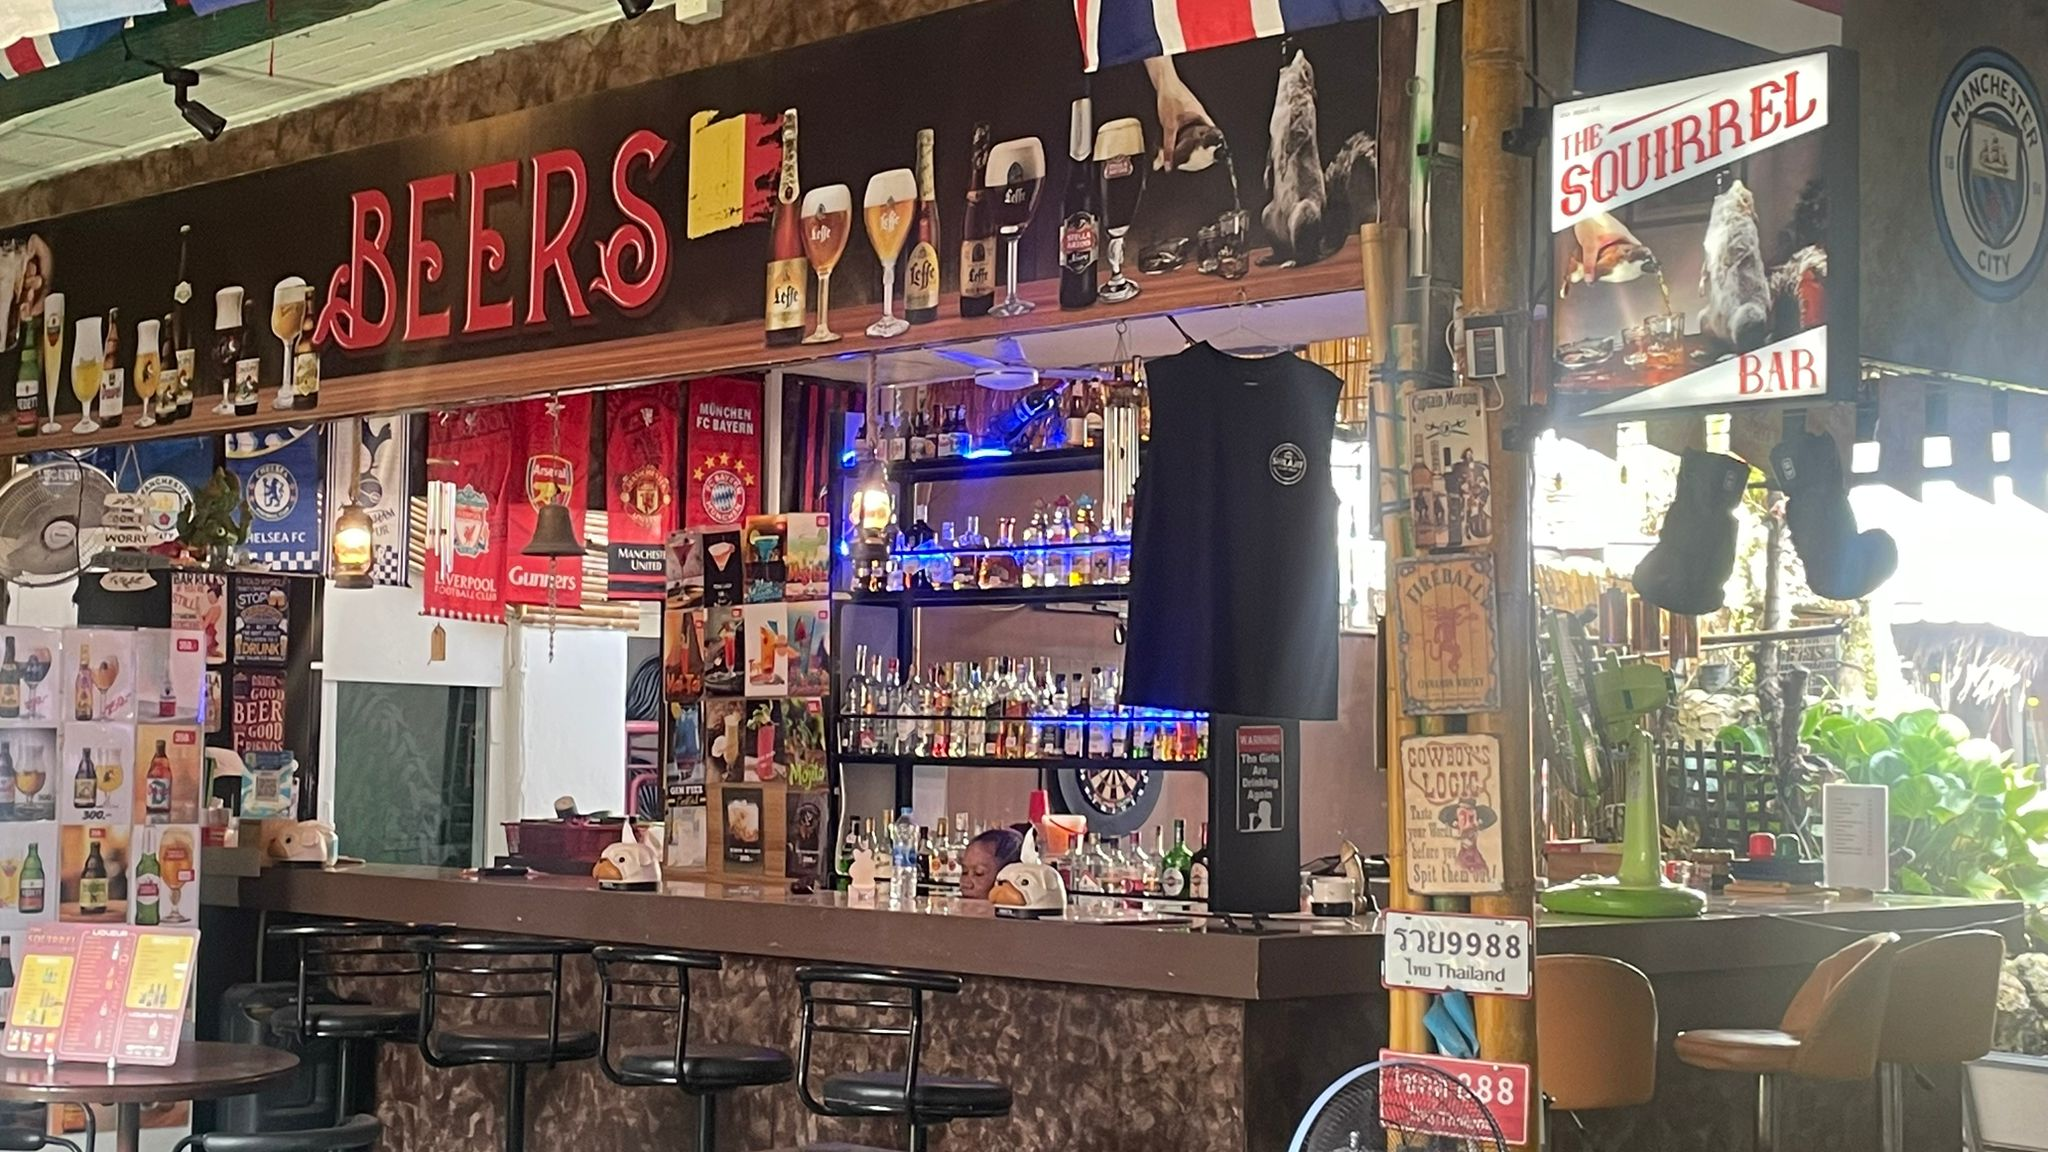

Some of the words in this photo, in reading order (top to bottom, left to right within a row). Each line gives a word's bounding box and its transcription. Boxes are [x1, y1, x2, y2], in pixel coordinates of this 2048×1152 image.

[1950, 74, 2039, 148] MANCHESTER
[1560, 71, 1817, 217] SQUIRREL
[1561, 123, 1603, 161] THE
[312, 130, 671, 350] BEERS
[810, 224, 831, 243] Leffe
[1977, 251, 2011, 275] CITY
[909, 259, 935, 290] Leffe
[968, 267, 989, 283] Leffe
[773, 285, 799, 309] Leffe
[1738, 348, 1820, 395] BAR
[700, 403, 751, 420] MÜNCHEN
[1412, 393, 1446, 414] Captain
[1443, 390, 1478, 409] Morgan
[696, 416, 710, 430] FC
[712, 419, 754, 435] BAYERN
[105, 534, 148, 544] WORRY
[246, 531, 289, 543] HELSEA
[291, 532, 306, 543] FC
[618, 548, 666, 560] MANCHESTE
[631, 559, 662, 572] UNITED
[508, 565, 576, 591] Gunners
[1406, 567, 1483, 605] FIREBALL
[238, 592, 268, 604] STOP
[434, 585, 474, 599] FOOTBALL
[475, 591, 498, 602] CLUB
[241, 643, 280, 656] DRUNK
[250, 687, 285, 701] GOOD
[234, 700, 283, 725] BEER
[248, 722, 283, 741] GOOD
[1240, 753, 1257, 764] The
[1259, 753, 1280, 764] Girls
[1407, 745, 1491, 768] COWBOY'S
[788, 763, 825, 790] Mojito
[1252, 765, 1268, 775] Are
[1242, 777, 1279, 789] Drinking
[1422, 770, 1480, 798] LOGIC
[1247, 789, 1273, 802] Again
[1410, 805, 1433, 820] Taste
[1429, 821, 1453, 838] Word
[1411, 842, 1439, 860] before
[1413, 863, 1437, 889] Spit
[1442, 863, 1469, 883] them
[1404, 956, 1431, 977] ไทย
[1435, 962, 1506, 983] Thailand
